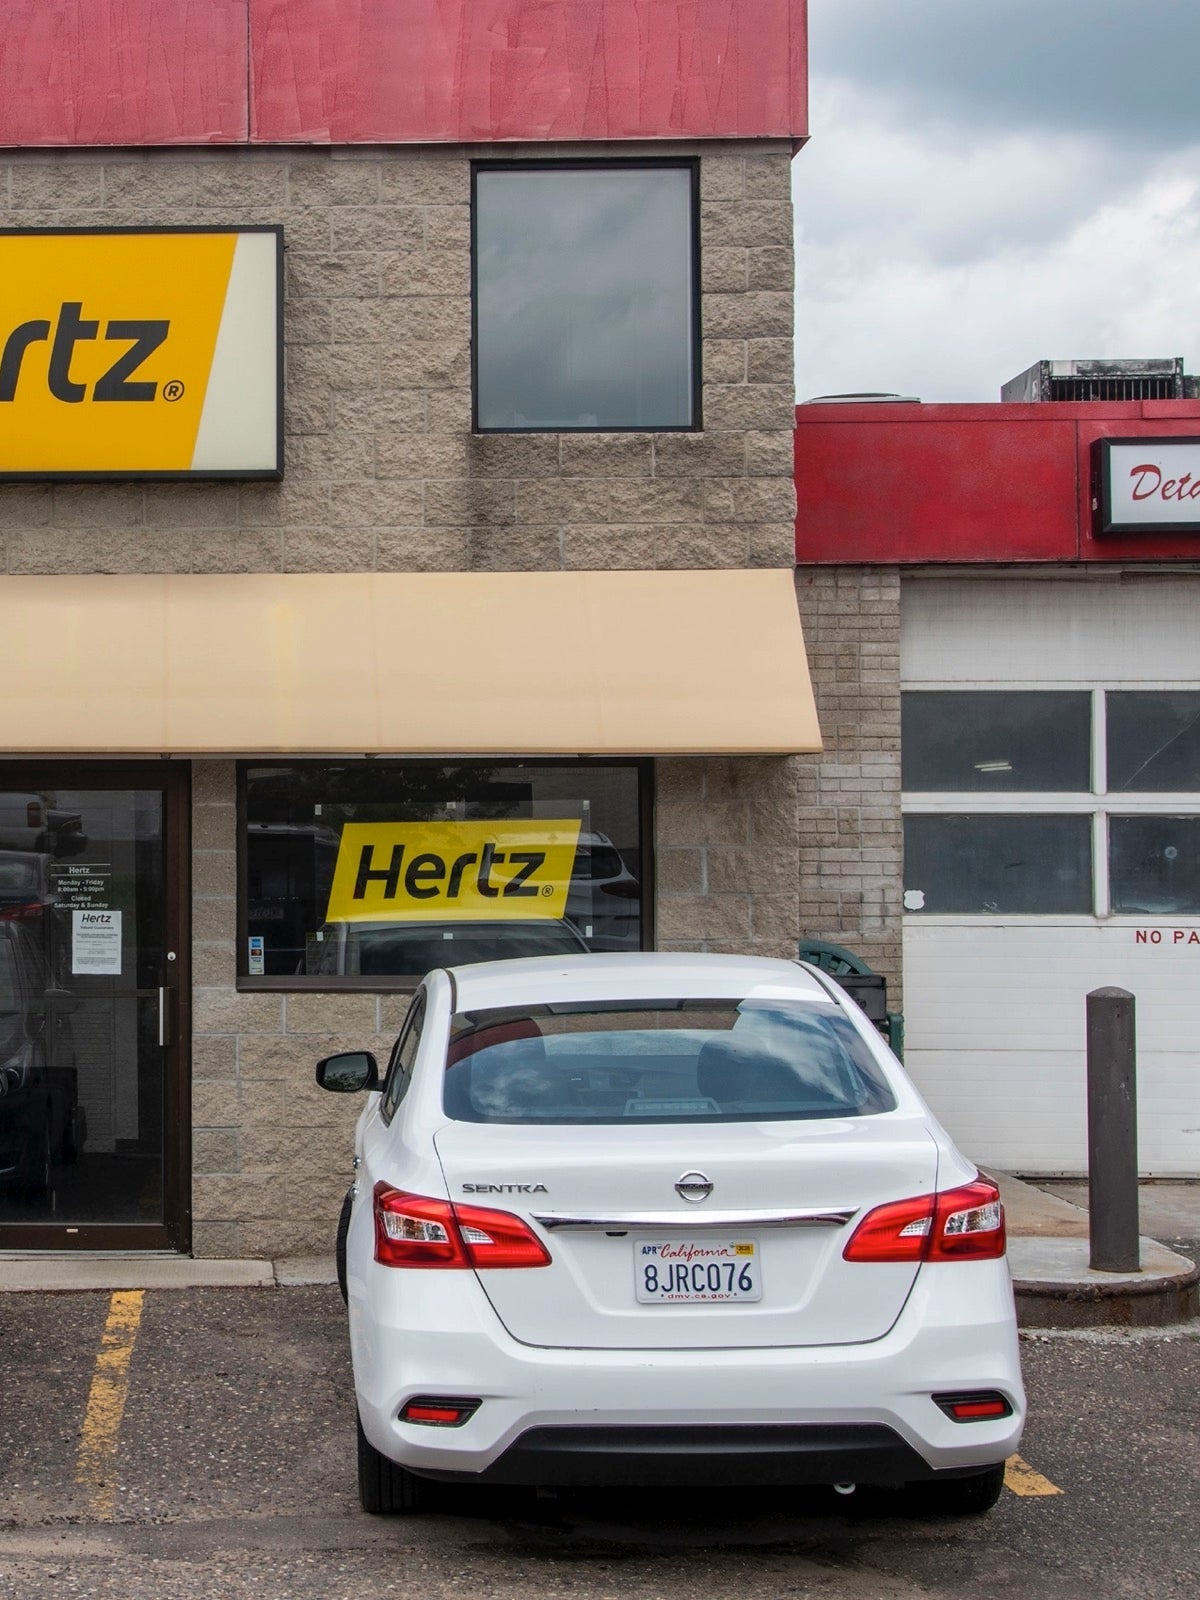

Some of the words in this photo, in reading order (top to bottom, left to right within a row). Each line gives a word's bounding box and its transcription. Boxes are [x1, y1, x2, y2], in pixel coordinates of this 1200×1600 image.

[68, 866, 90, 874] Hertz
[81, 913, 112, 923] Hertz
[1135, 930, 1162, 944] NO
[461, 1183, 549, 1194] SENTRA
[641, 1245, 658, 1255] APR
[660, 1243, 737, 1262] California
[644, 1262, 753, 1293] 8JRC076
